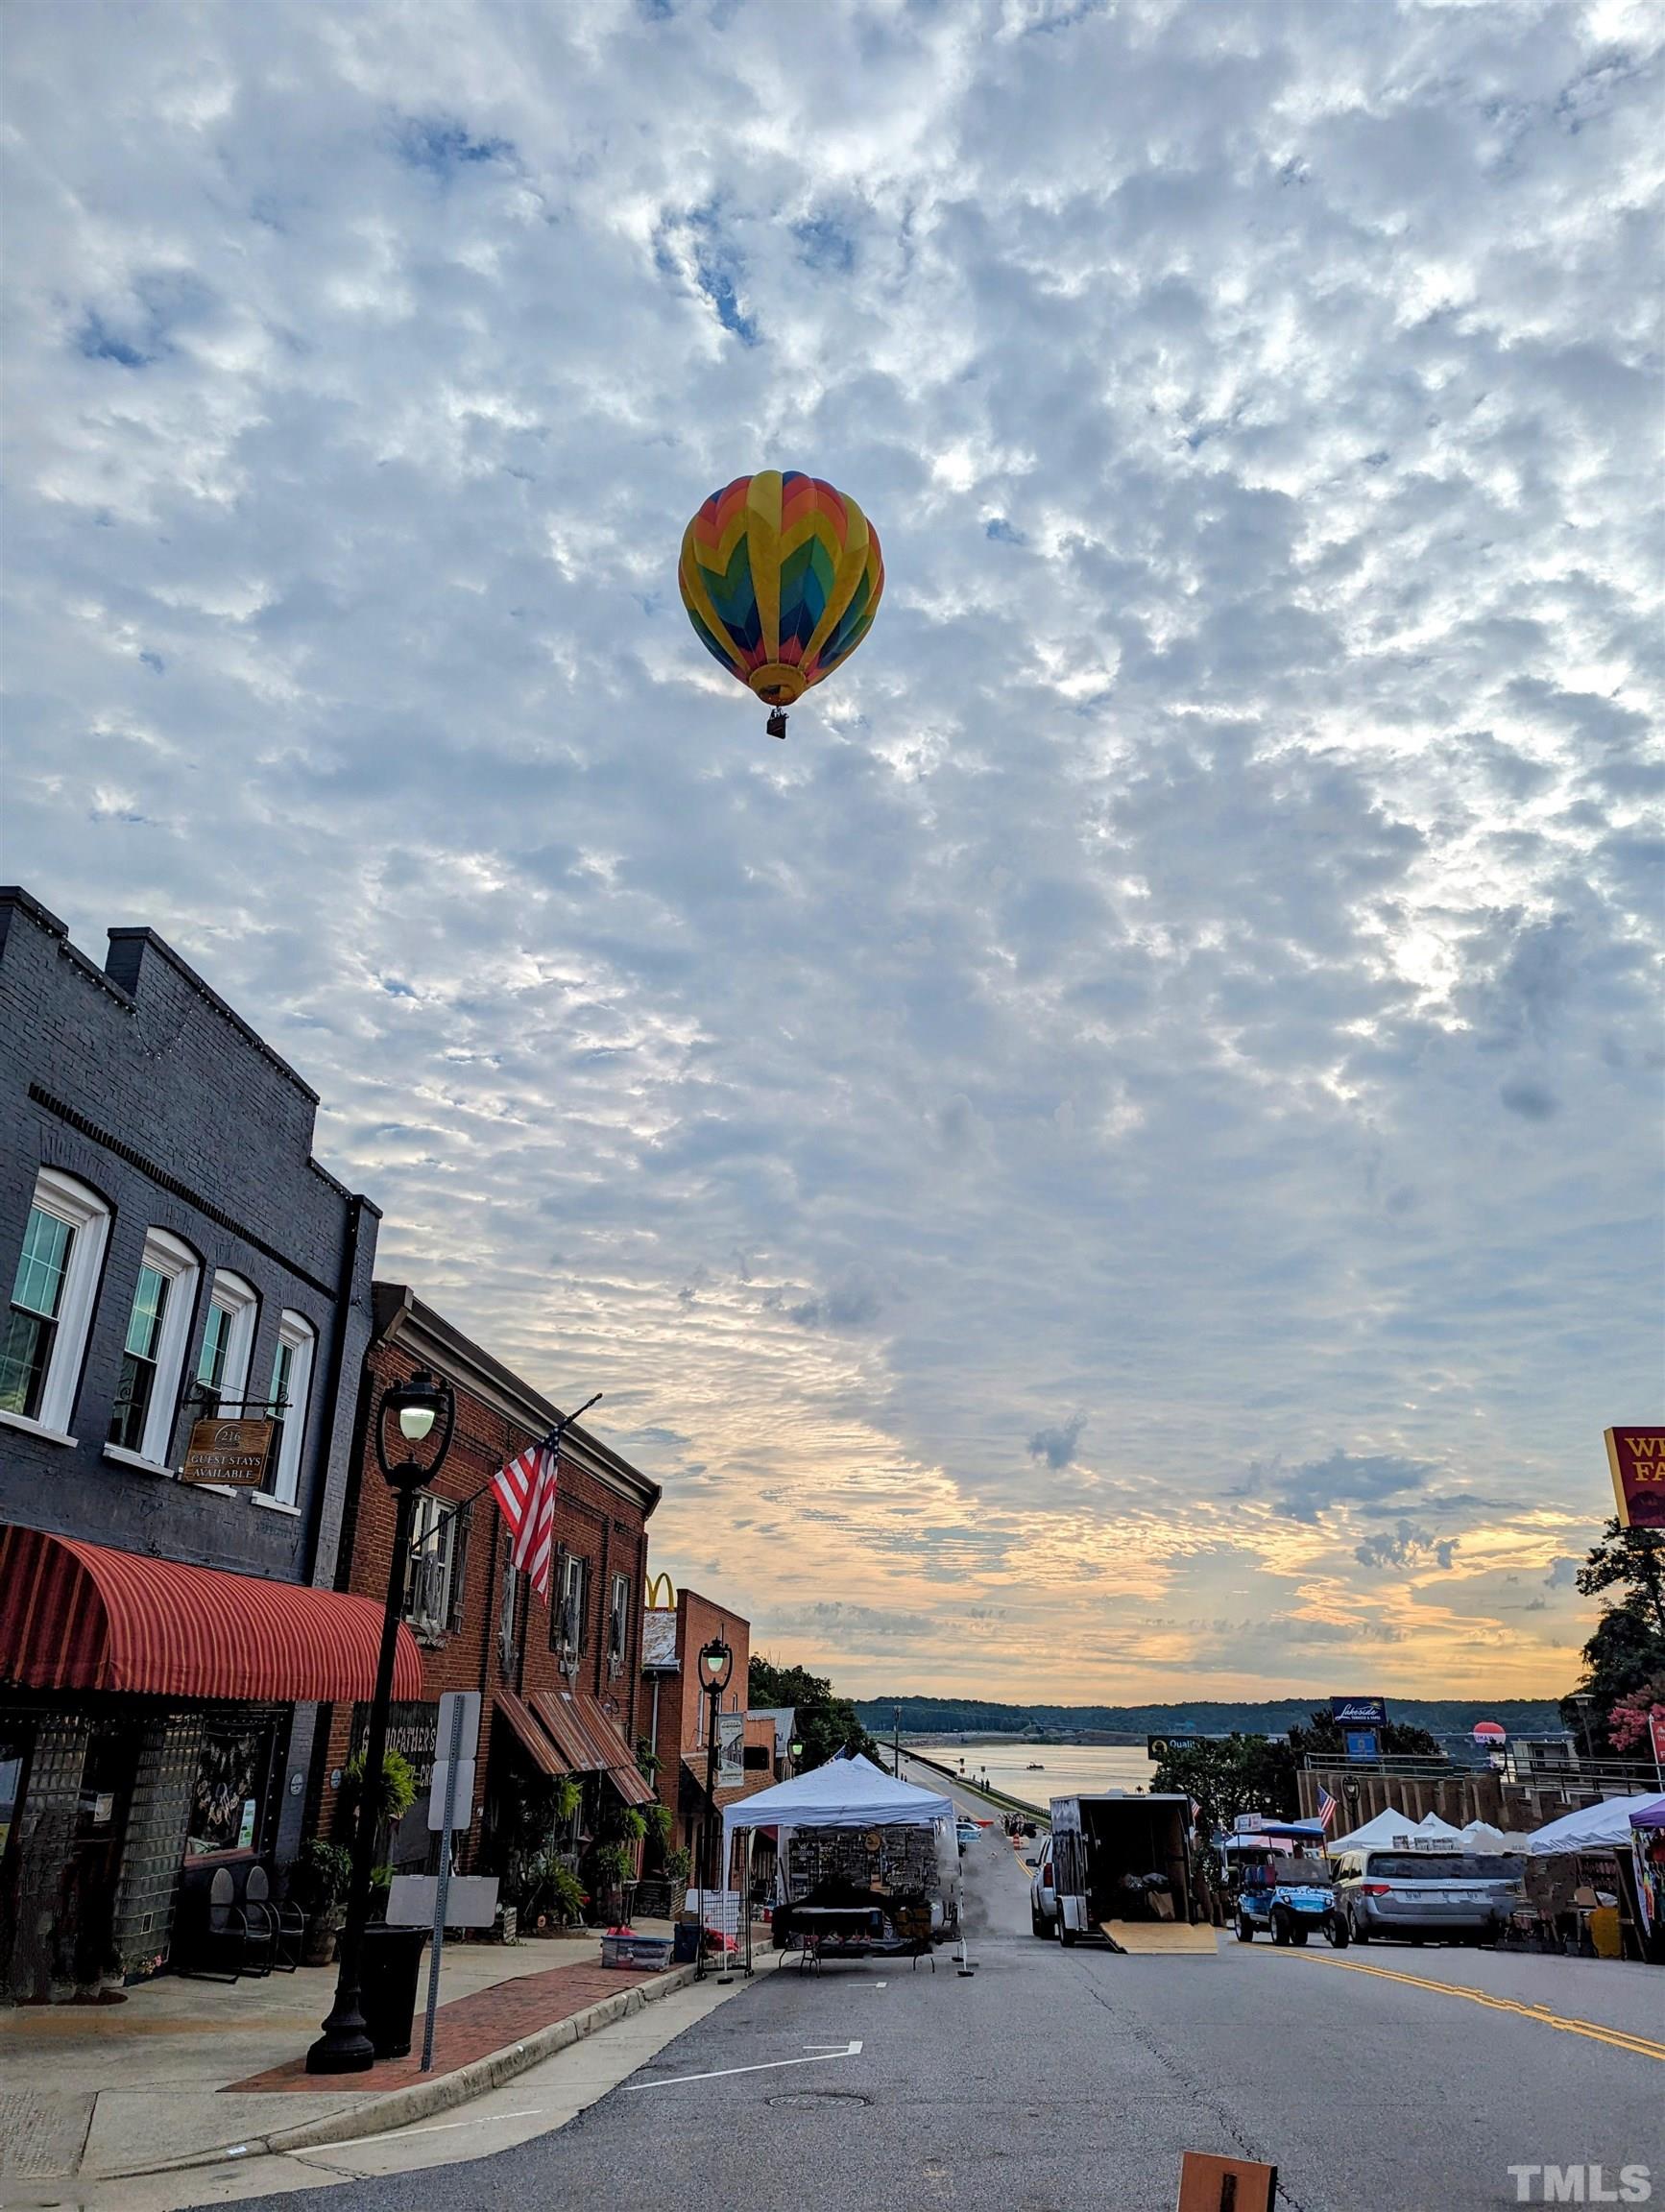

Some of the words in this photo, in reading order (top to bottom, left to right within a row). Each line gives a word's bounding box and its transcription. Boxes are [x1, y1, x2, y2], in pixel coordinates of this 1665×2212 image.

[221, 1431, 241, 1441] 216
[191, 1455, 226, 1465] GUEST
[229, 1456, 261, 1466] STAYS
[193, 1469, 253, 1479] AVAILABLE
[1335, 1703, 1378, 1721] Lakeside
